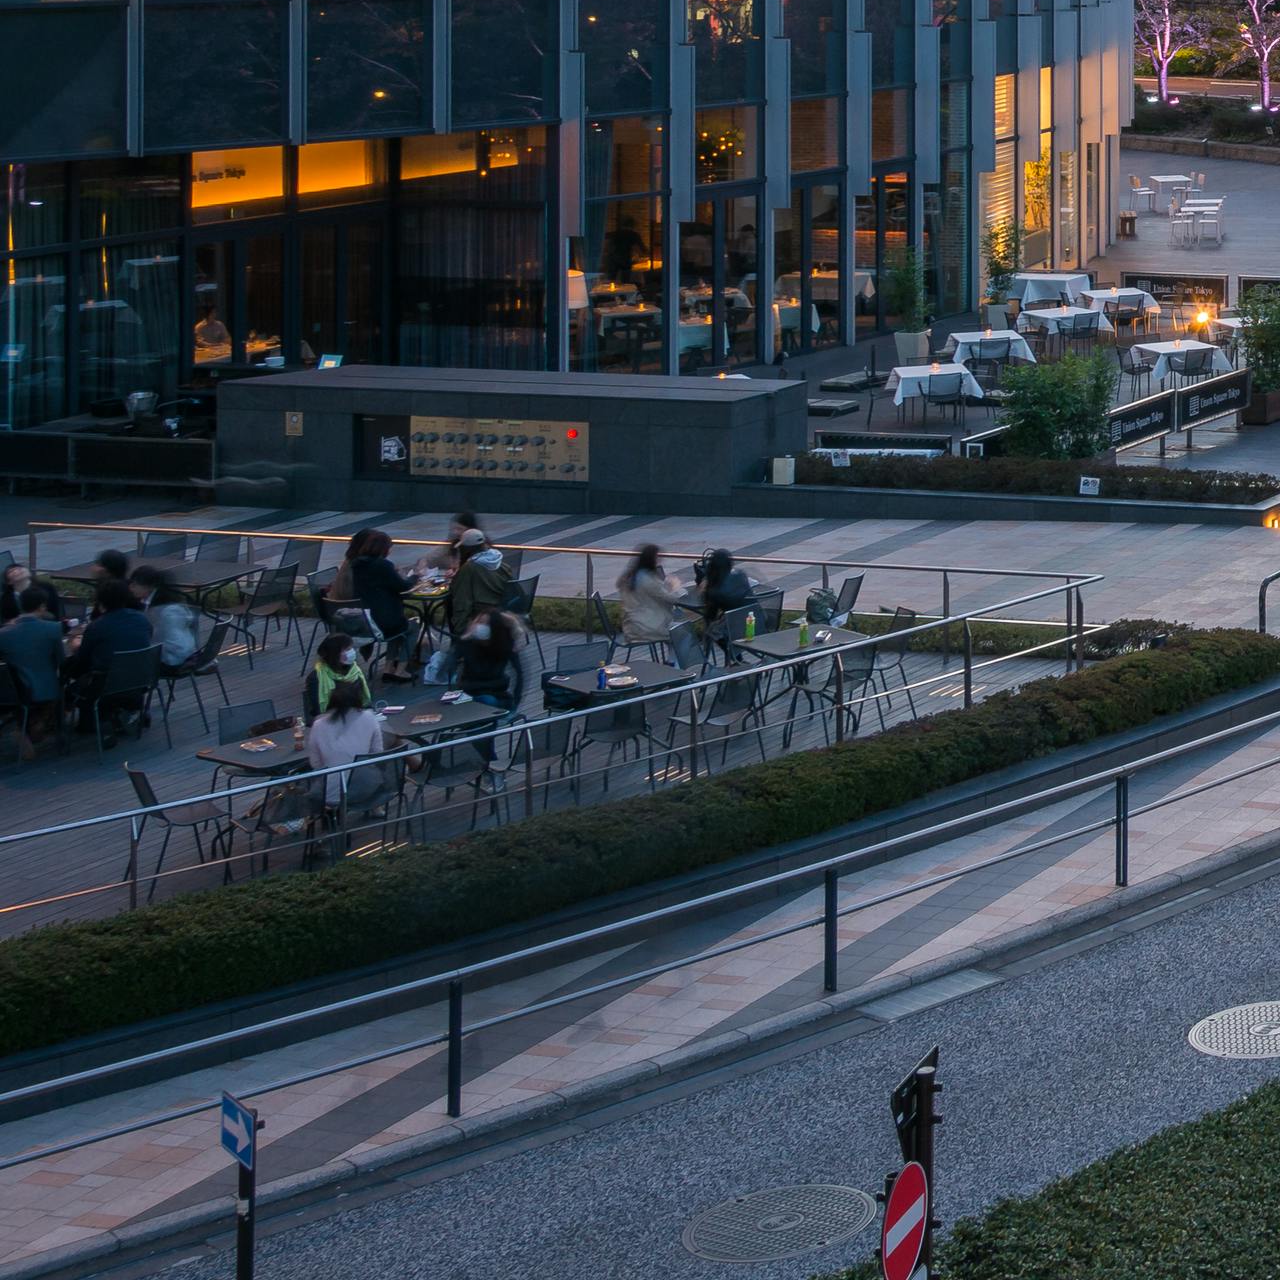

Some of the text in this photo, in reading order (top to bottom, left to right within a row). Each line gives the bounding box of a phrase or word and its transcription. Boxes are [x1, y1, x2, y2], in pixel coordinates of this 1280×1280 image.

[1194, 285, 1214, 297] Tokyo
[1213, 392, 1228, 404] Square
[1227, 387, 1241, 400] Tokyo
[1135, 417, 1151, 429] Square
[1151, 410, 1165, 423] Tokyo
